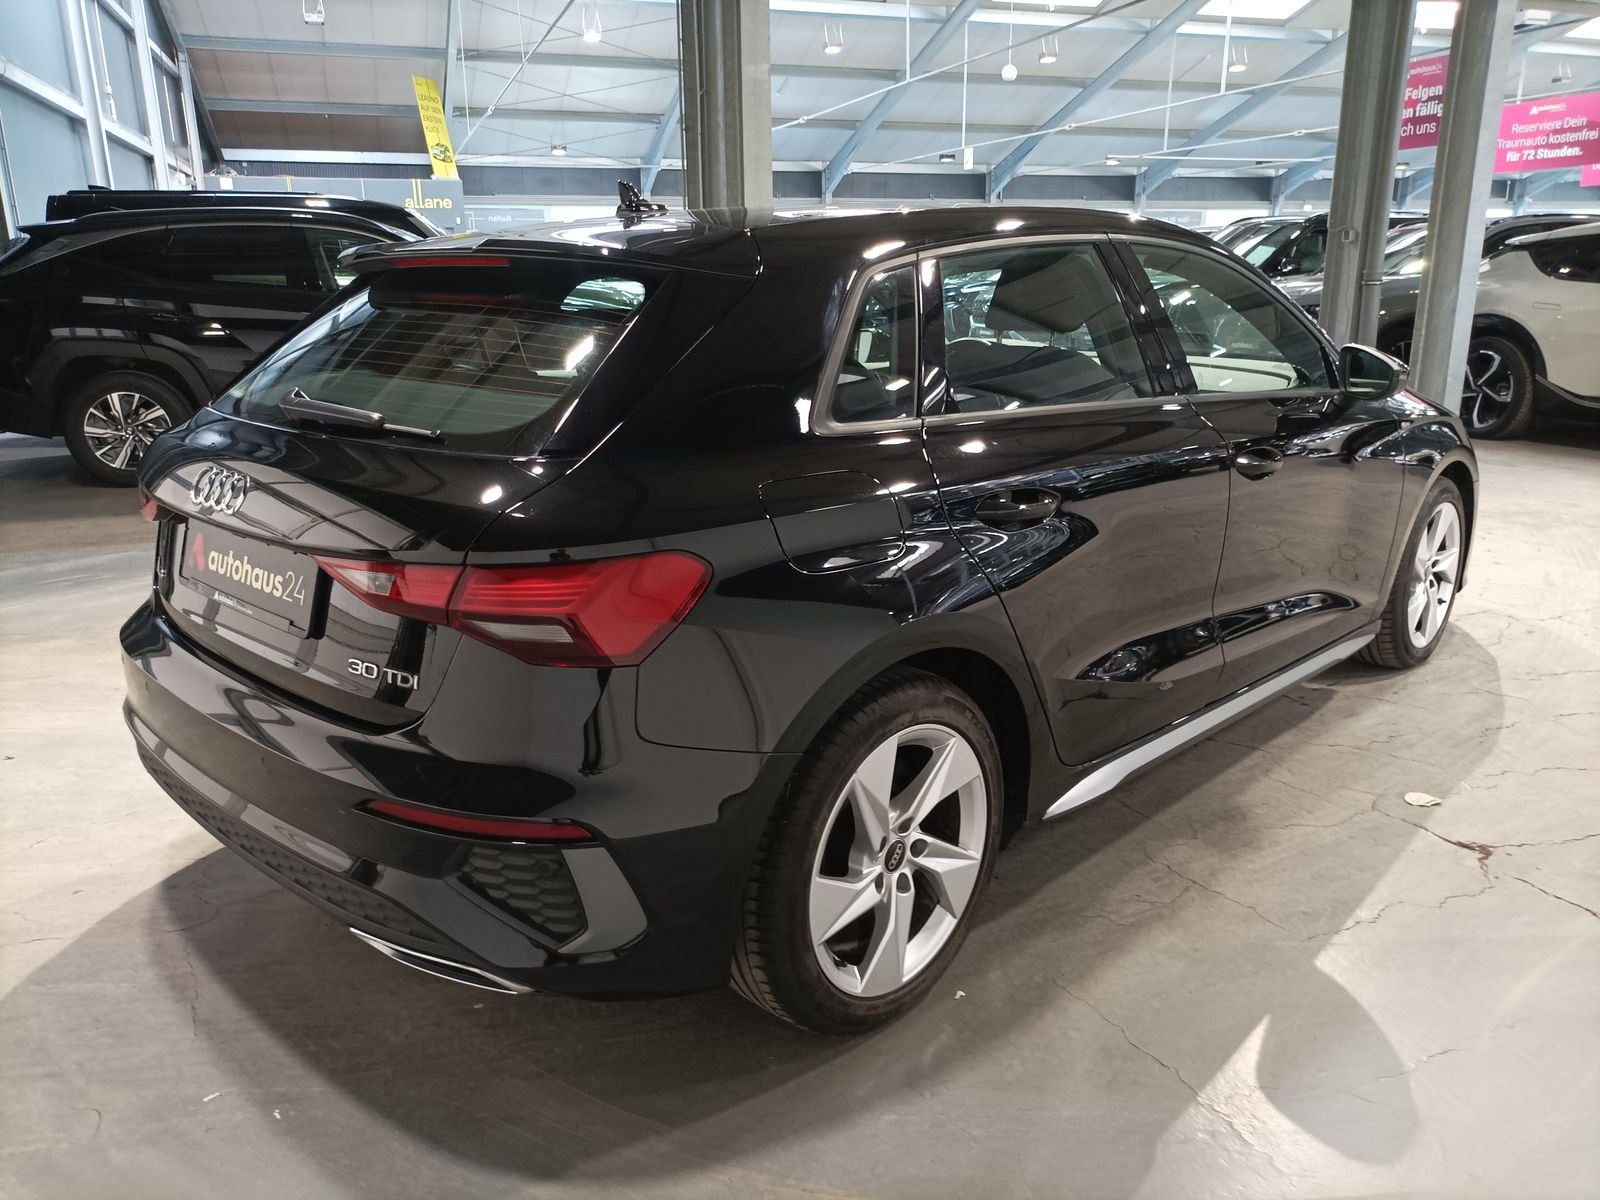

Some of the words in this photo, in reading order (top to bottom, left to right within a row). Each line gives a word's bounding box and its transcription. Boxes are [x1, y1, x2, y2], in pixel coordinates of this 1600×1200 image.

[1405, 84, 1443, 101] Felgen
[1416, 122, 1437, 135] uns
[1511, 120, 1562, 134] Reserviere
[1563, 115, 1587, 129] Dein
[1498, 136, 1547, 149] Traumauto
[1548, 128, 1599, 144] kostenfrei
[1506, 150, 1521, 162] für
[1522, 149, 1536, 161] 72
[1536, 145, 1584, 160] Stunden.
[404, 179, 453, 209] allane
[207, 550, 306, 607] autohaus24
[347, 658, 378, 680] 30
[382, 667, 420, 691] TDI
